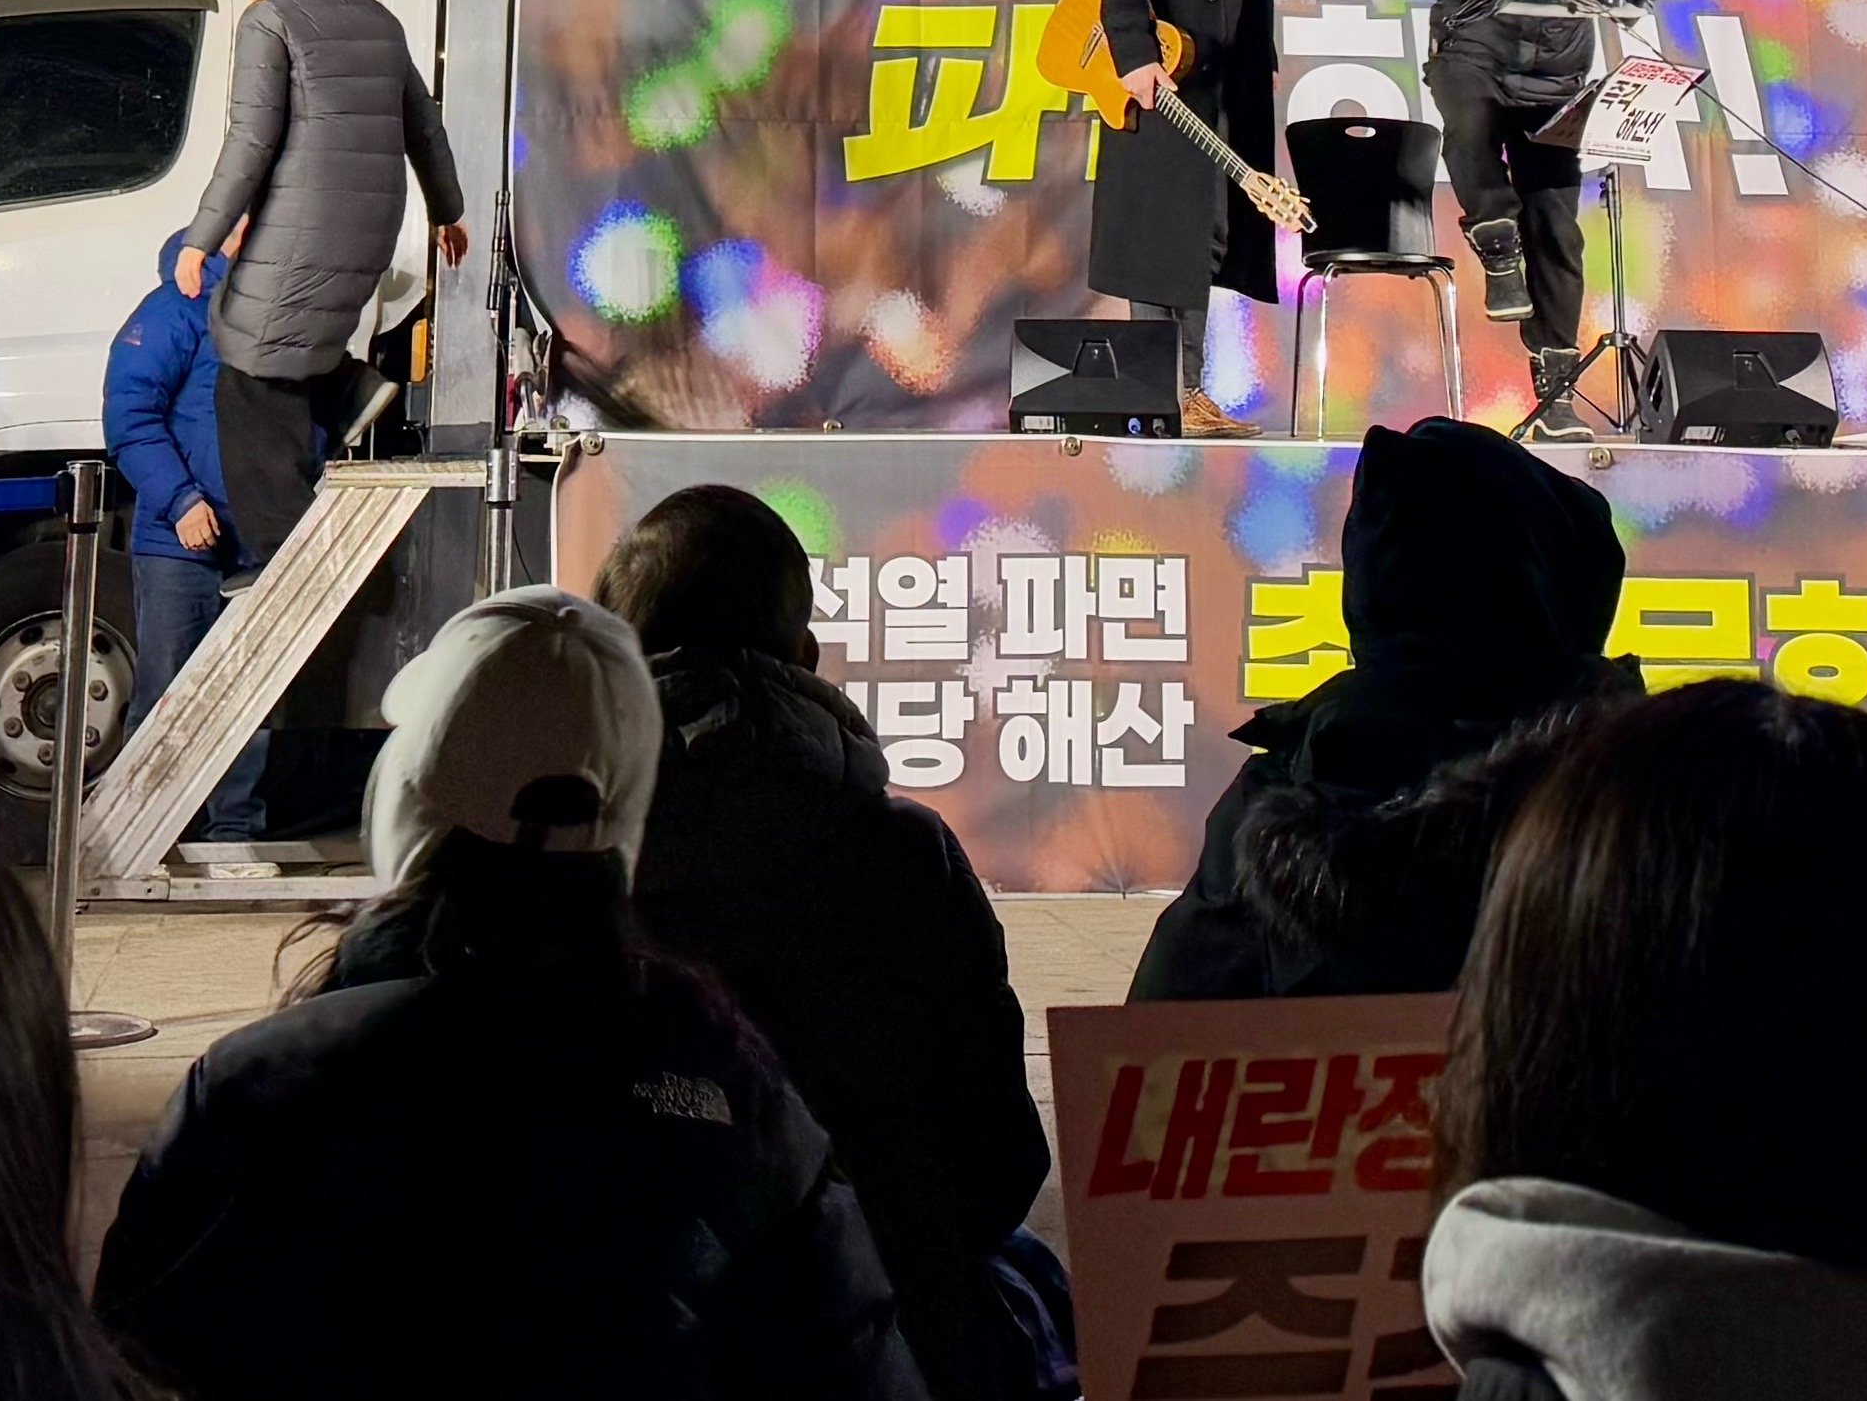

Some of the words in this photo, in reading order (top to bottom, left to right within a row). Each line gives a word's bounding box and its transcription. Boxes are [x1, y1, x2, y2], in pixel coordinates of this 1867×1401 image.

[1600, 80, 1648, 113] 즉각
[808, 555, 970, 663] 석열
[999, 555, 1188, 662] 파면
[996, 679, 1195, 788] 해산
